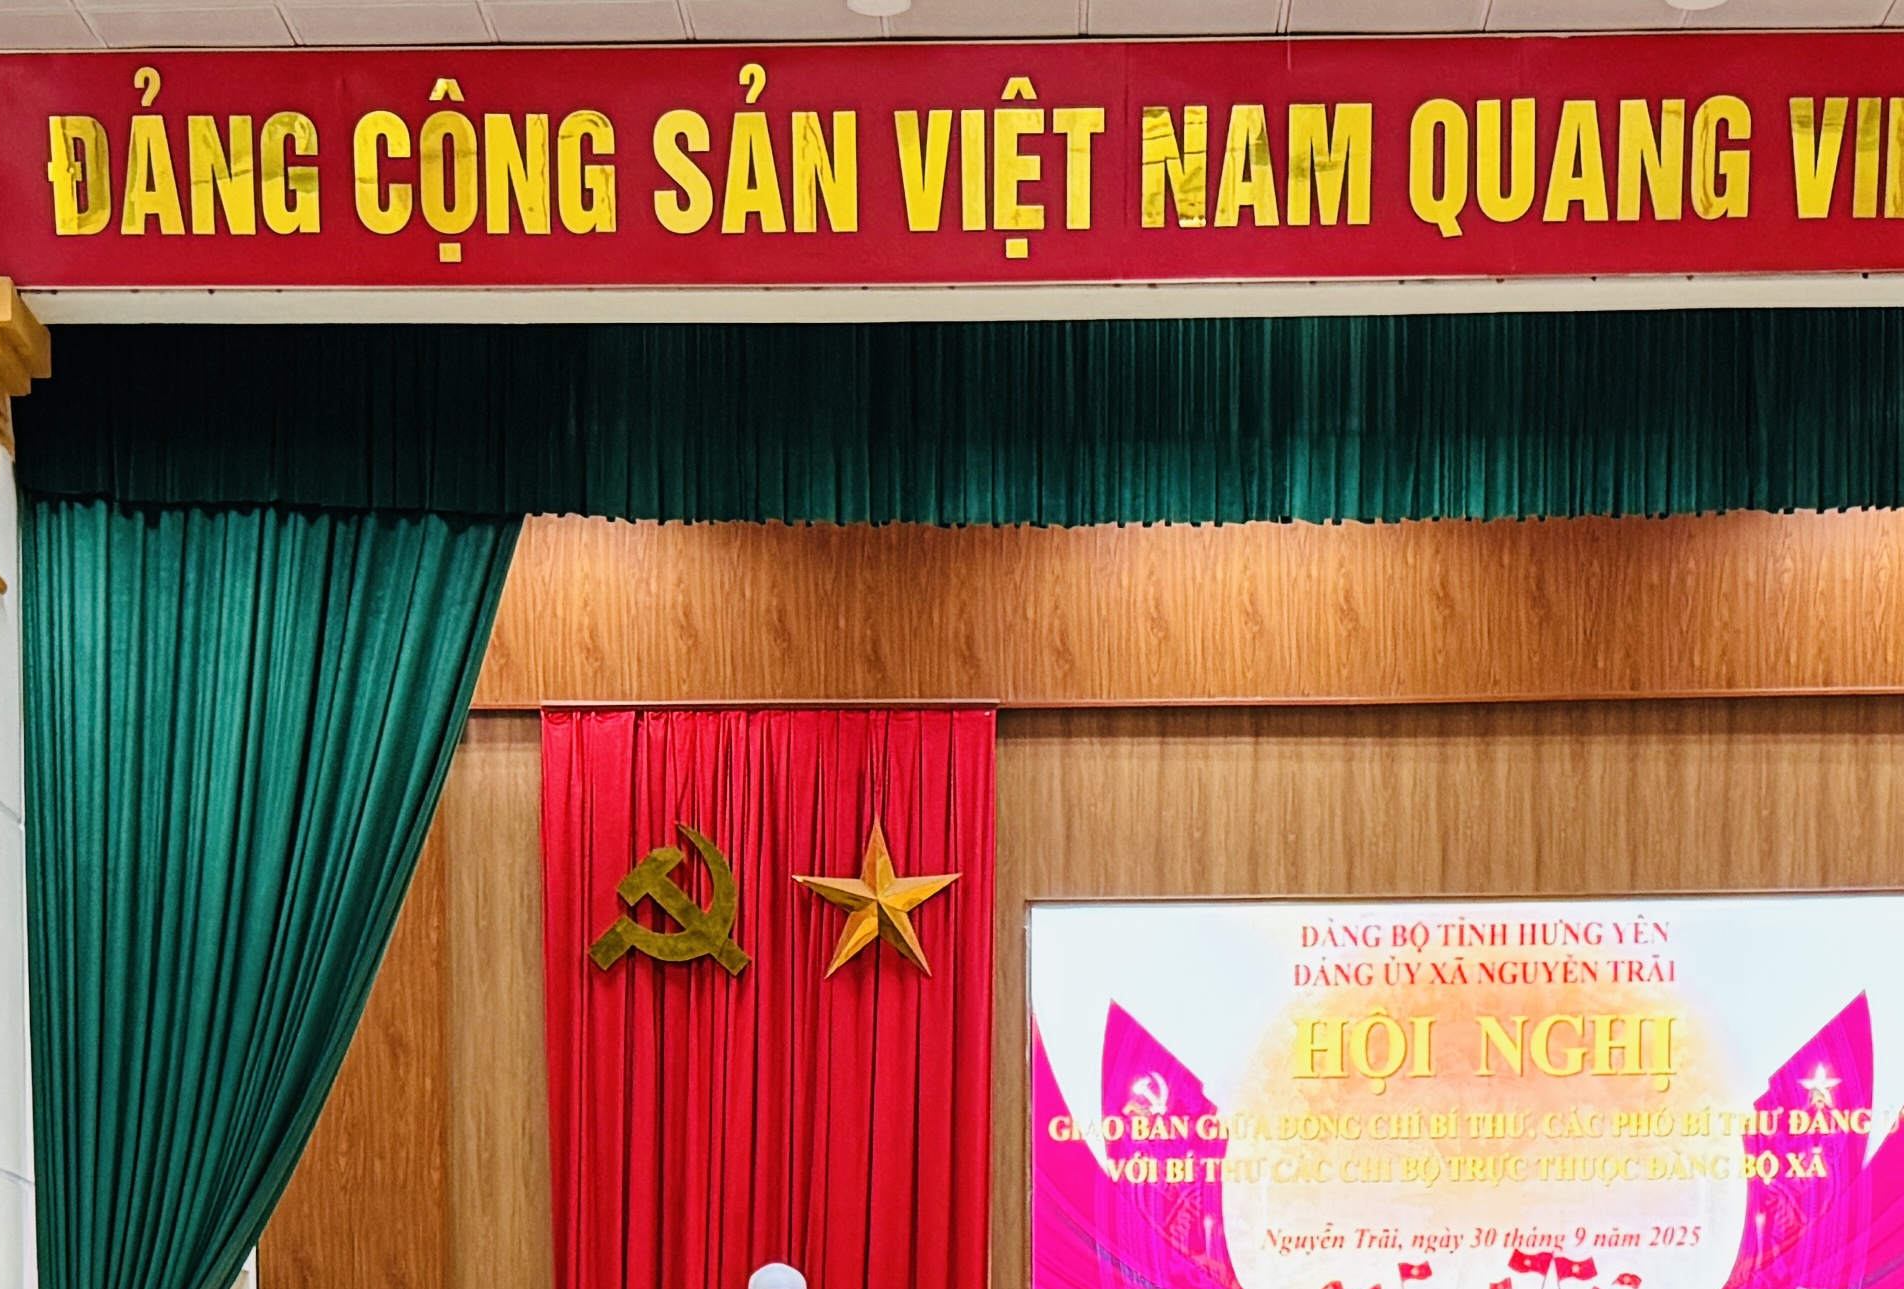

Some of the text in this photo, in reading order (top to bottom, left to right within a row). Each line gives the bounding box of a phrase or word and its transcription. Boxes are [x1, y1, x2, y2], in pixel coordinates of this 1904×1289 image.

[48, 67, 320, 235] ĐẢNG
[353, 78, 616, 262] CỘNG
[653, 63, 858, 234] SẢN
[894, 76, 1105, 258] VIỆT
[1142, 103, 1372, 228] NAM
[1409, 95, 1751, 237] QUANG
[1392, 921, 1430, 953] BỘ
[1437, 916, 1507, 947] TỈNH
[1519, 919, 1603, 947] HƯNG
[1613, 914, 1670, 945] YÊN
[1384, 956, 1422, 985] ỦY
[1430, 957, 1468, 985] XÃ
[1607, 954, 1676, 984] TRÃI
[1292, 1007, 1678, 1094] HỘI NGHỊ
[1261, 1223, 1345, 1254] Nguyễn
[1411, 1228, 1464, 1254] ngày
[1470, 1228, 1497, 1248] 30
[1503, 1226, 1566, 1250] tháng
[1573, 1226, 1586, 1248] 9
[1593, 1227, 1641, 1248] năm
[1649, 1225, 1702, 1248] 2025
